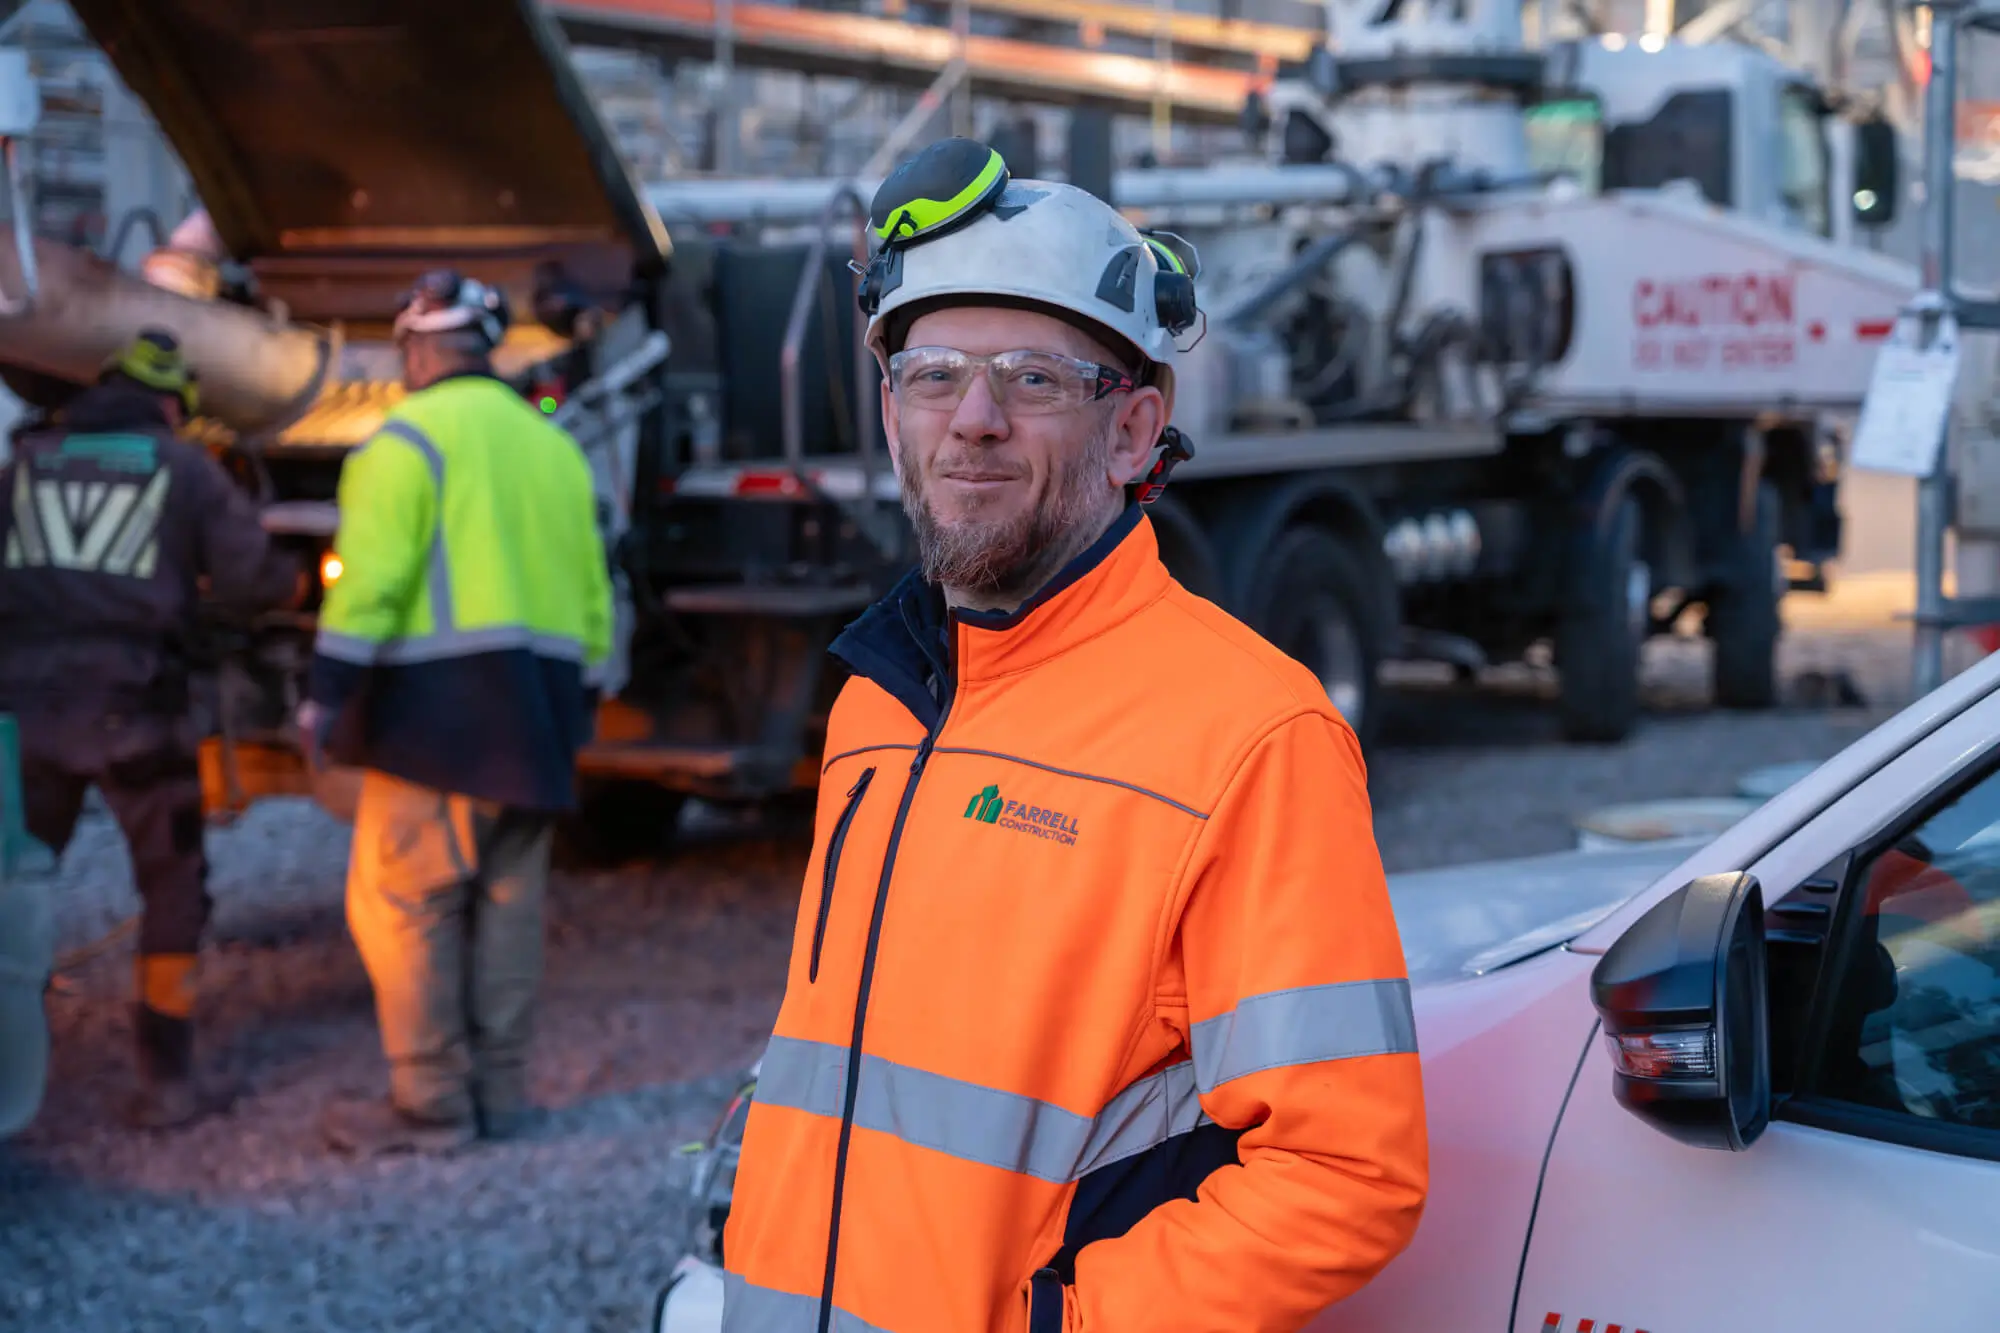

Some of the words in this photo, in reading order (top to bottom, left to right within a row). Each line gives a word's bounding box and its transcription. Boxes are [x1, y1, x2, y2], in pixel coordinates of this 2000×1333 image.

[1634, 272, 1796, 326] CAUTION
[999, 817, 1077, 846] CONSTRUCTION
[1003, 800, 1079, 835] FARRELL
